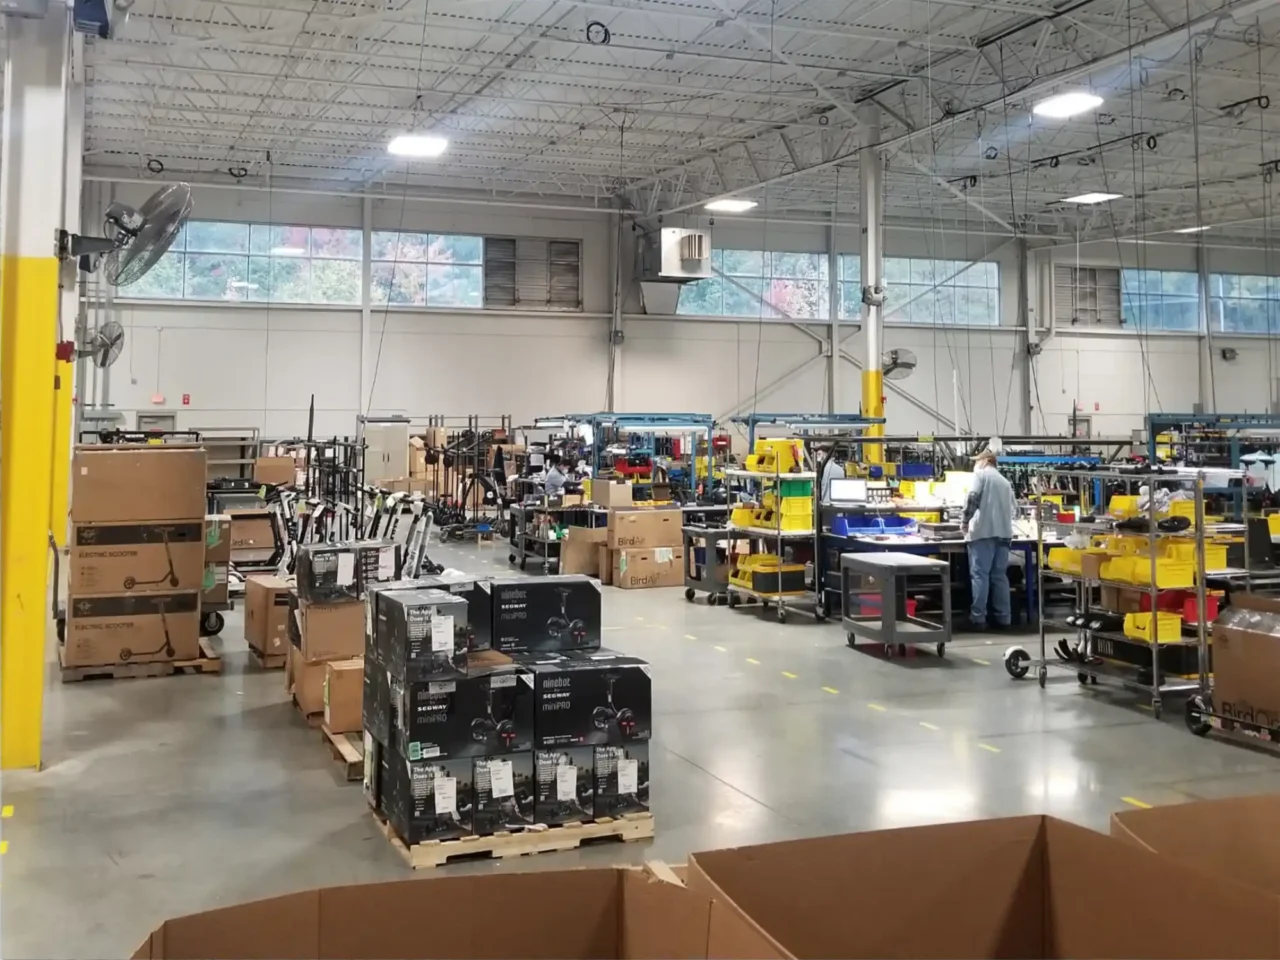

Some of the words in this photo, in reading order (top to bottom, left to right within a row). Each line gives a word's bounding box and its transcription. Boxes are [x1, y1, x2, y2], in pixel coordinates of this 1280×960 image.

[501, 589, 527, 600] ninebot
[501, 612, 527, 620] miniPRO
[543, 677, 571, 688] ninebot
[543, 702, 571, 711] miniPRO
